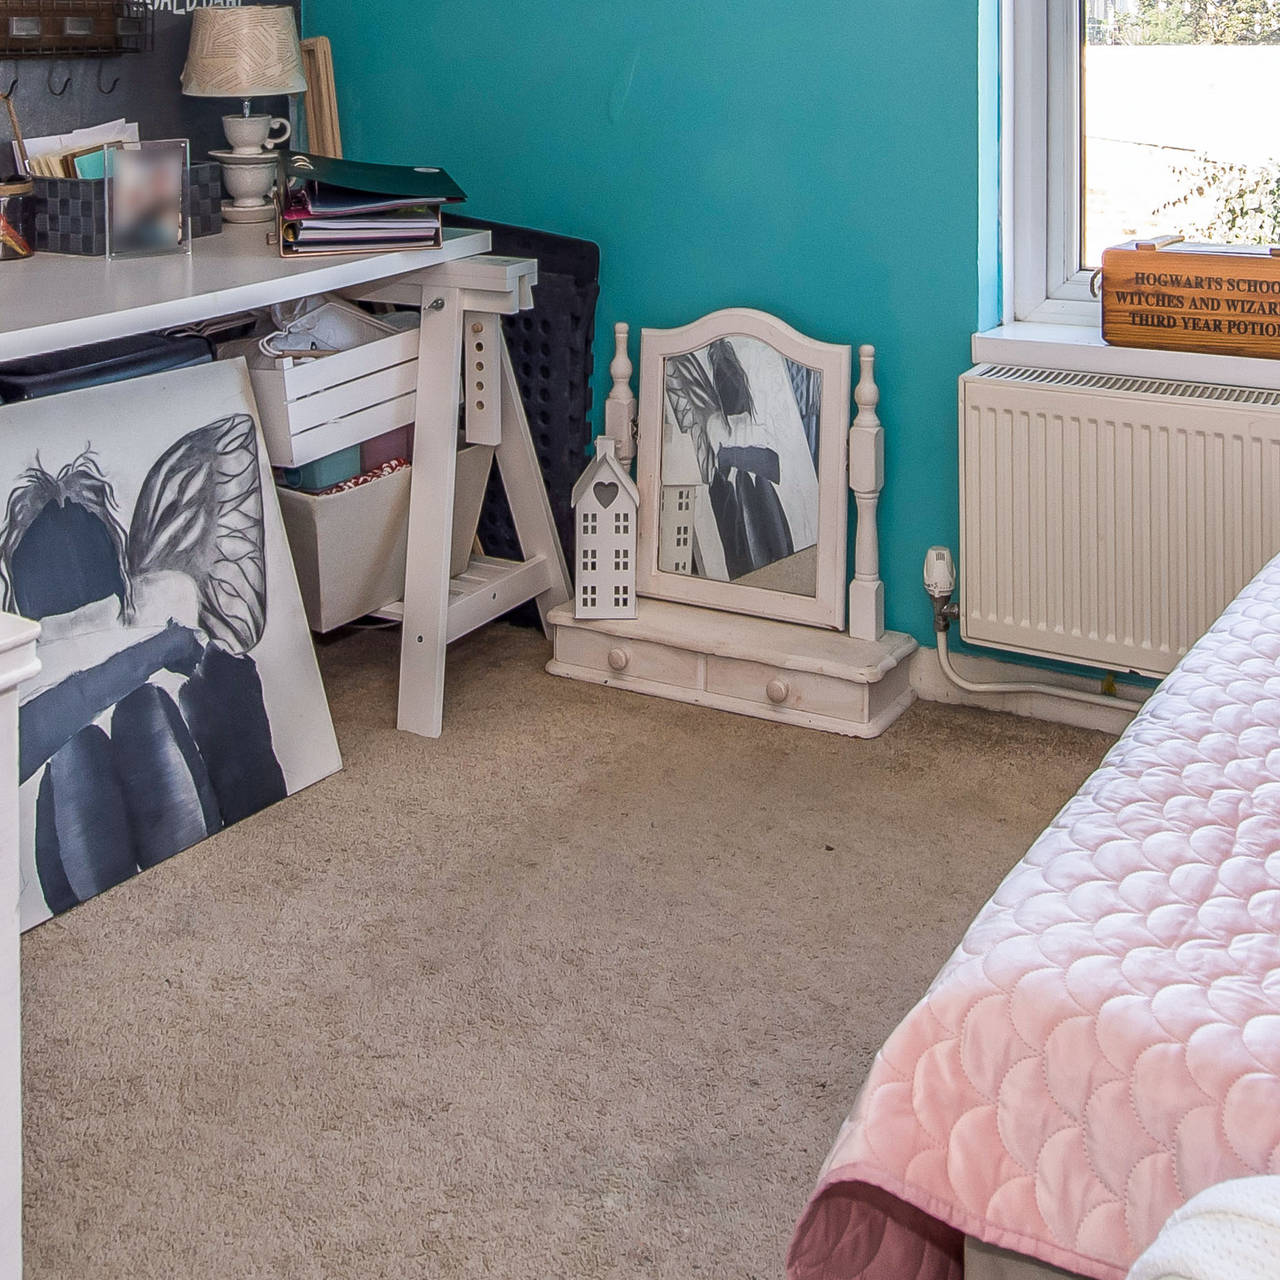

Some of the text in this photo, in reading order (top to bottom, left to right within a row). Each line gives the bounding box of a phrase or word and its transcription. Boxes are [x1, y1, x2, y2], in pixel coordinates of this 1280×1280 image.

[1134, 272, 1223, 291] HOGWARTS
[1115, 291, 1185, 309] WITCHES
[1189, 297, 1221, 312] AND
[1128, 312, 1177, 329] THIRD
[1181, 317, 1223, 333] YEAR
